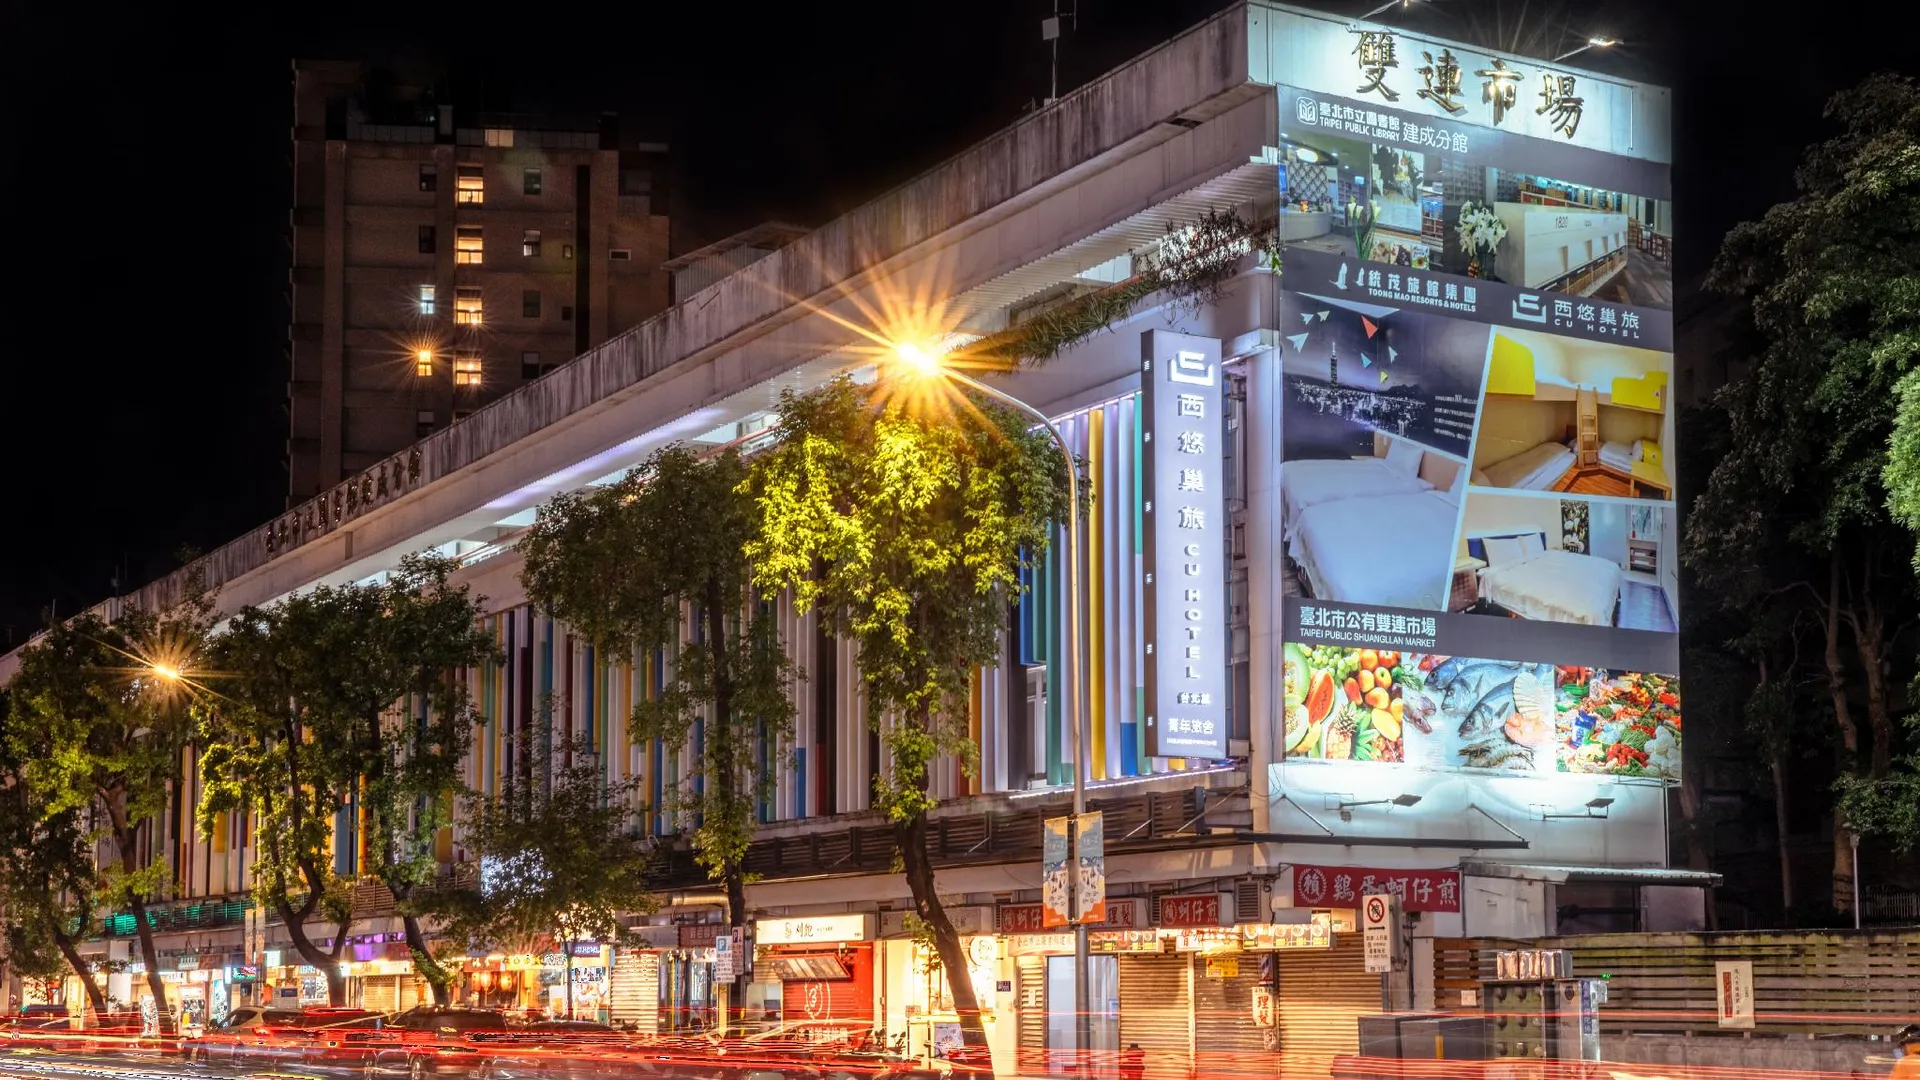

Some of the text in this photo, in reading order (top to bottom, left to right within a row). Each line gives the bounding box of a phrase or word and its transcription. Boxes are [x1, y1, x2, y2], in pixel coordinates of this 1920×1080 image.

[1352, 31, 1585, 139] 雙連市場
[1319, 102, 1468, 153] 臺北市立圖書館 建成分館
[1320, 116, 1400, 142] TAIPEI PUBLIC LIBRARY
[1368, 270, 1476, 304] 統茂旅館集團
[1394, 291, 1410, 302] MAO
[1411, 294, 1443, 307] RESORTS
[1443, 300, 1450, 308] &
[1450, 301, 1476, 312] HOTELS
[1554, 300, 1639, 329] 西悠巢旅
[1554, 318, 1640, 339] CU HOTEL
[1179, 394, 1205, 530] 西悠巢旅
[1186, 589, 1201, 679] HOTEL
[1300, 606, 1436, 637] 臺北市公有雙連市場
[1300, 628, 1324, 639] TAIPEI
[1324, 631, 1353, 641] PUBLIC
[1405, 637, 1436, 648] MARKET
